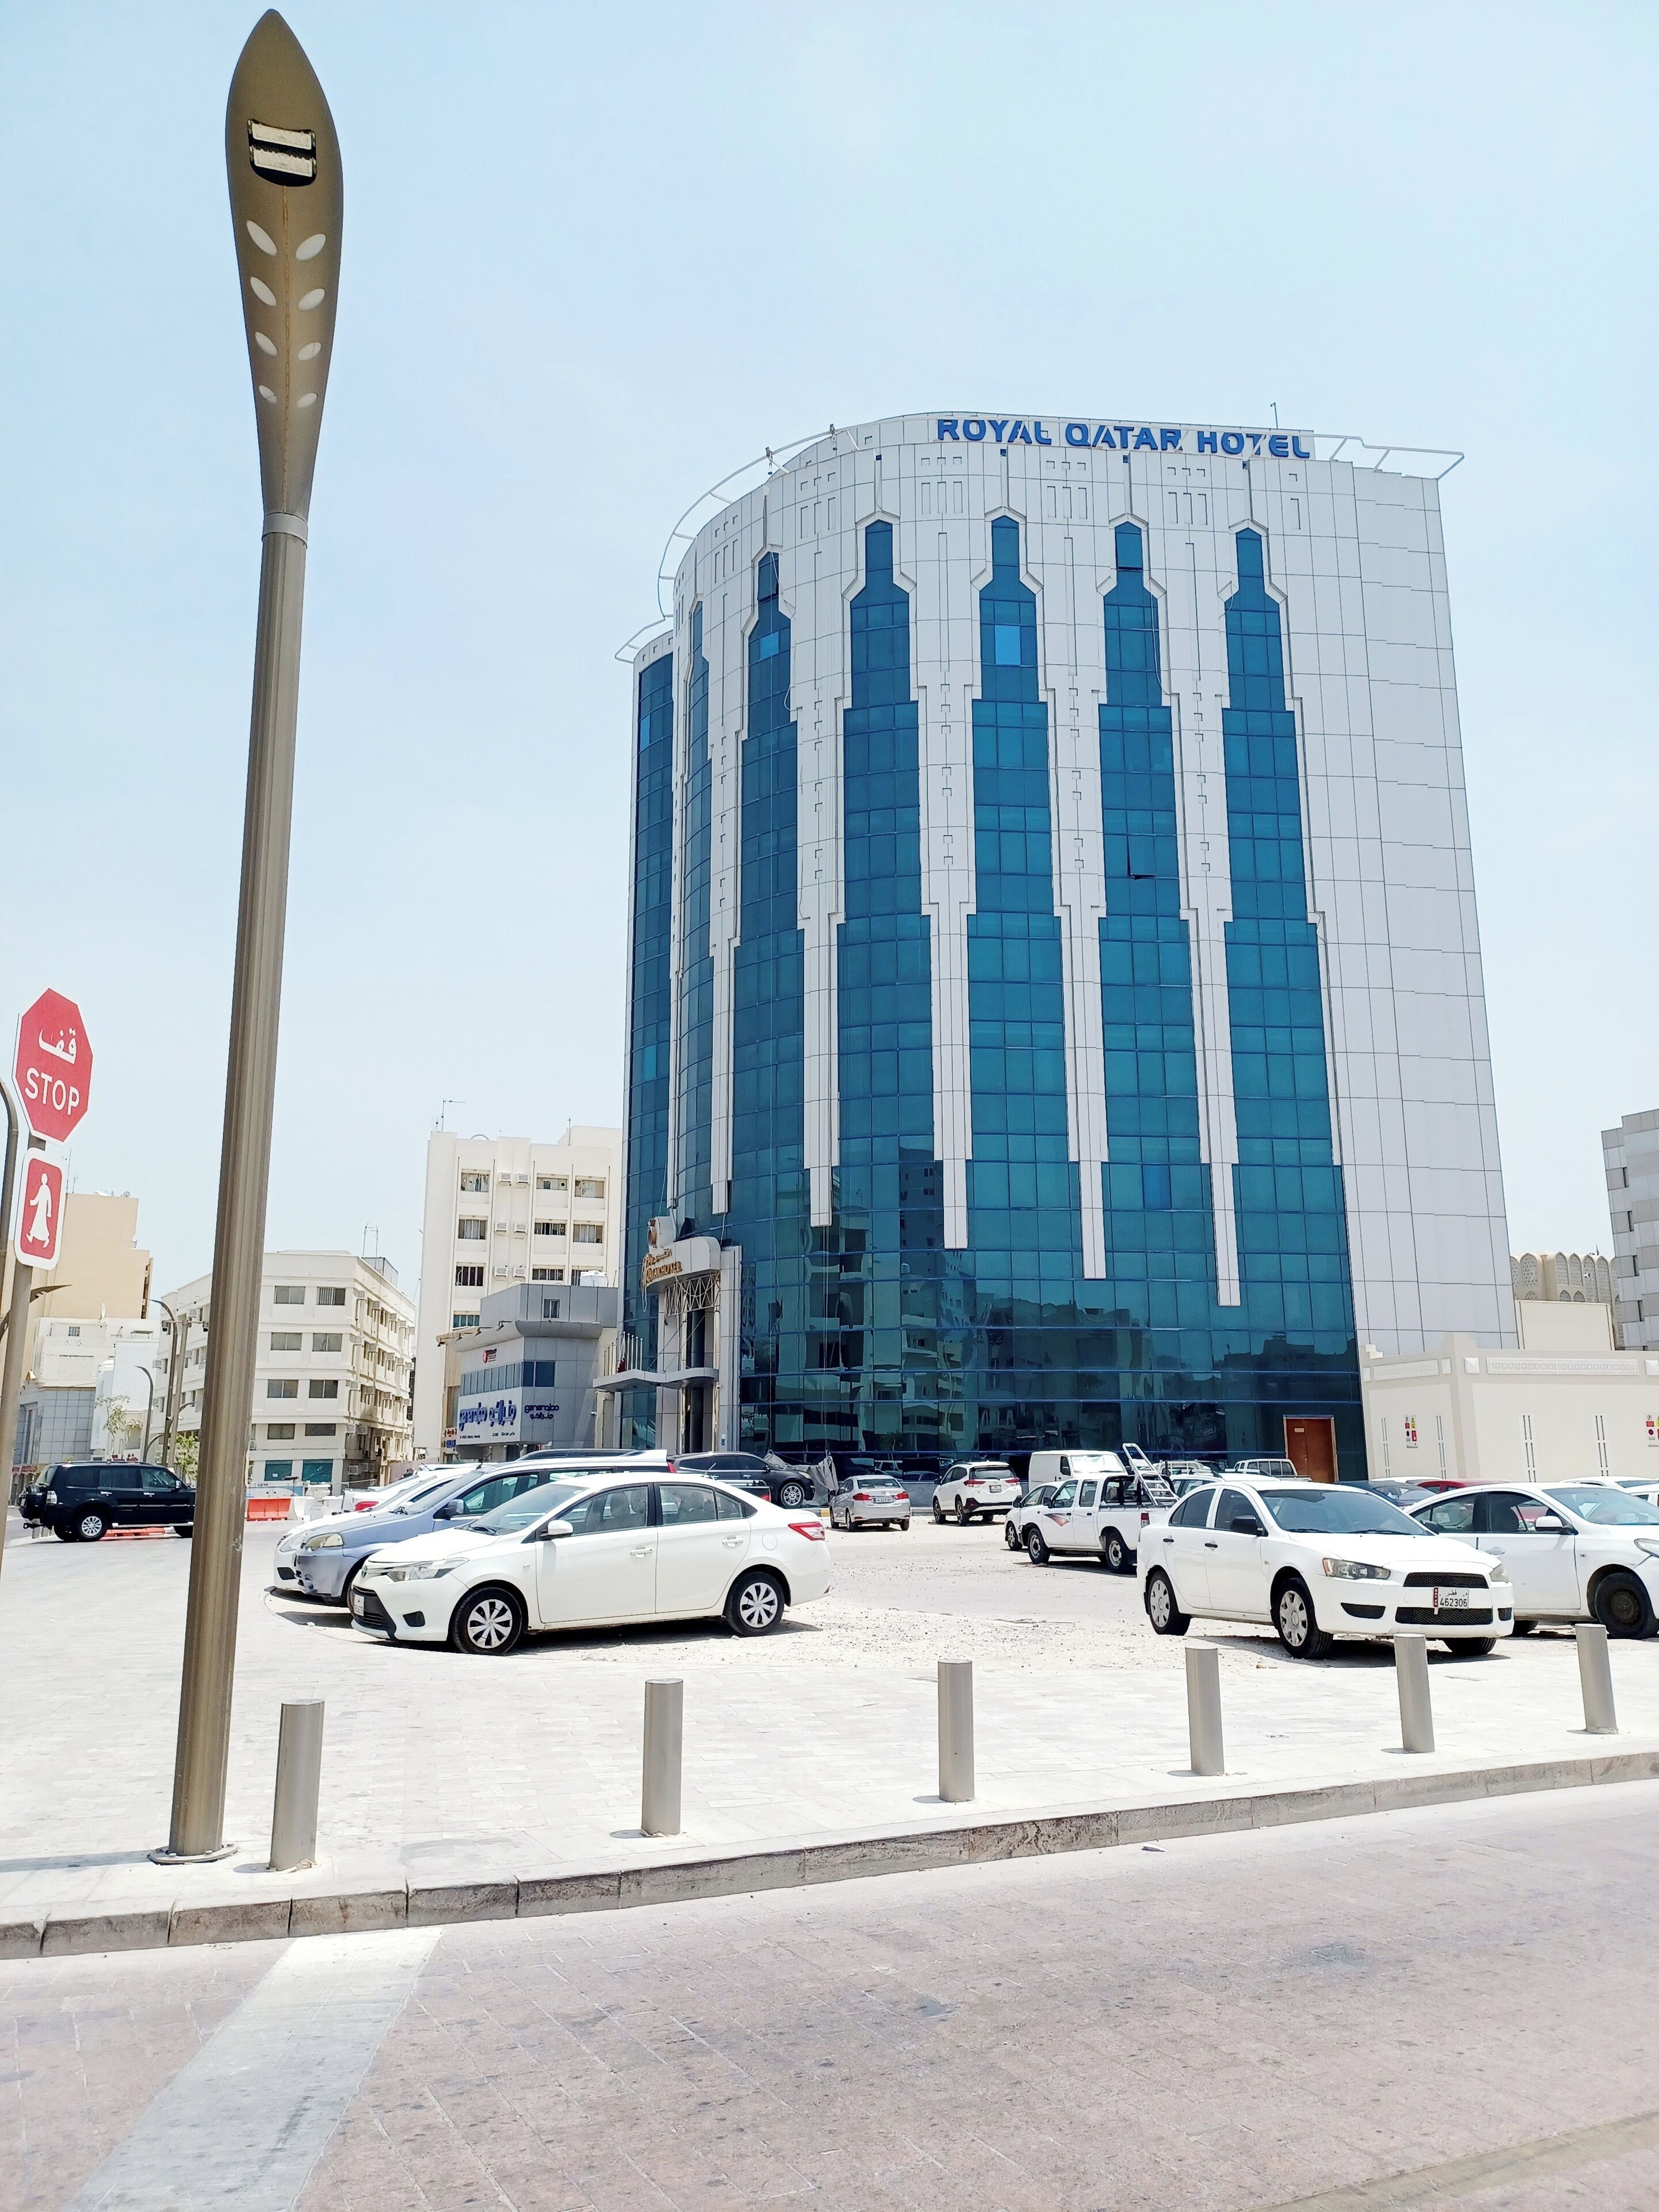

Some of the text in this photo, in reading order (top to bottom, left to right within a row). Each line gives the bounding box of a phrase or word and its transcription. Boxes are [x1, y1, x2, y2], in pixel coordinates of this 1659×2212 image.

[938, 419, 1310, 459] ROYAL QATAR HOTEL
[38, 1027, 77, 1065] قف
[24, 1067, 80, 1115] STOP
[1440, 1597, 1468, 1607] 462306
